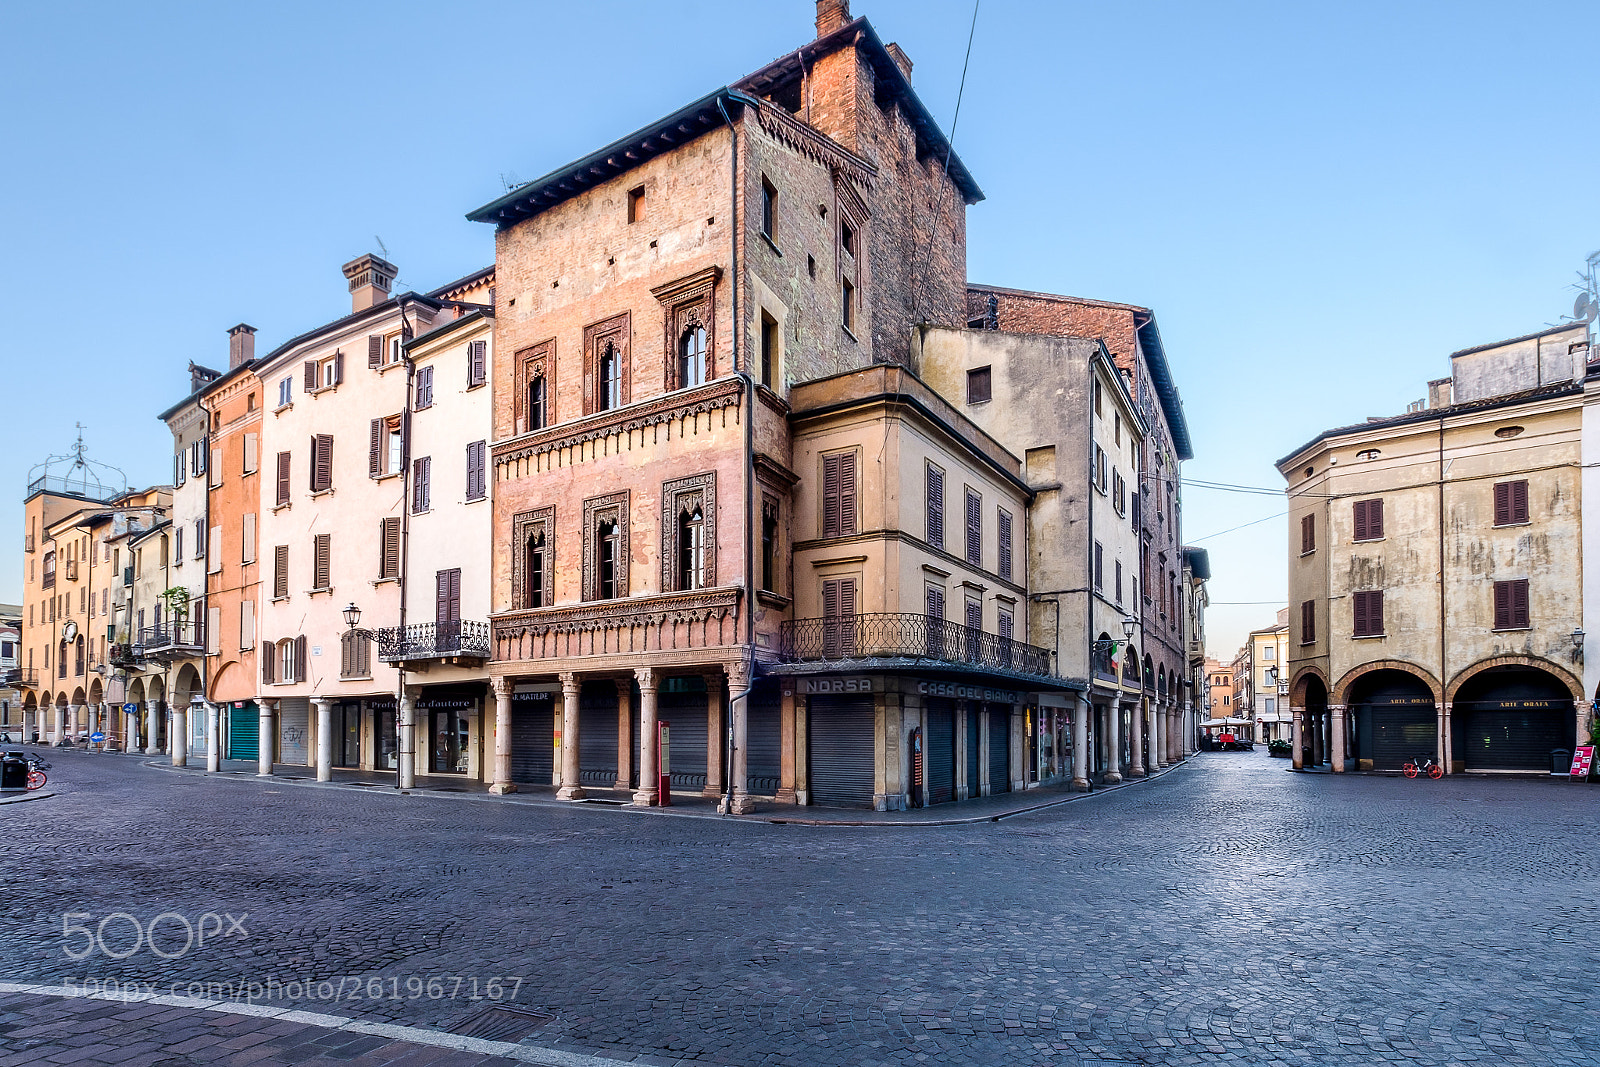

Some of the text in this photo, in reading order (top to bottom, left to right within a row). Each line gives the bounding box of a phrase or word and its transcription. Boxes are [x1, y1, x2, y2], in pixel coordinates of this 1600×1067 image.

[806, 679, 872, 692] NORSA
[918, 682, 955, 695] CASA
[957, 687, 981, 699] DEL
[428, 700, 470, 708] d'autore
